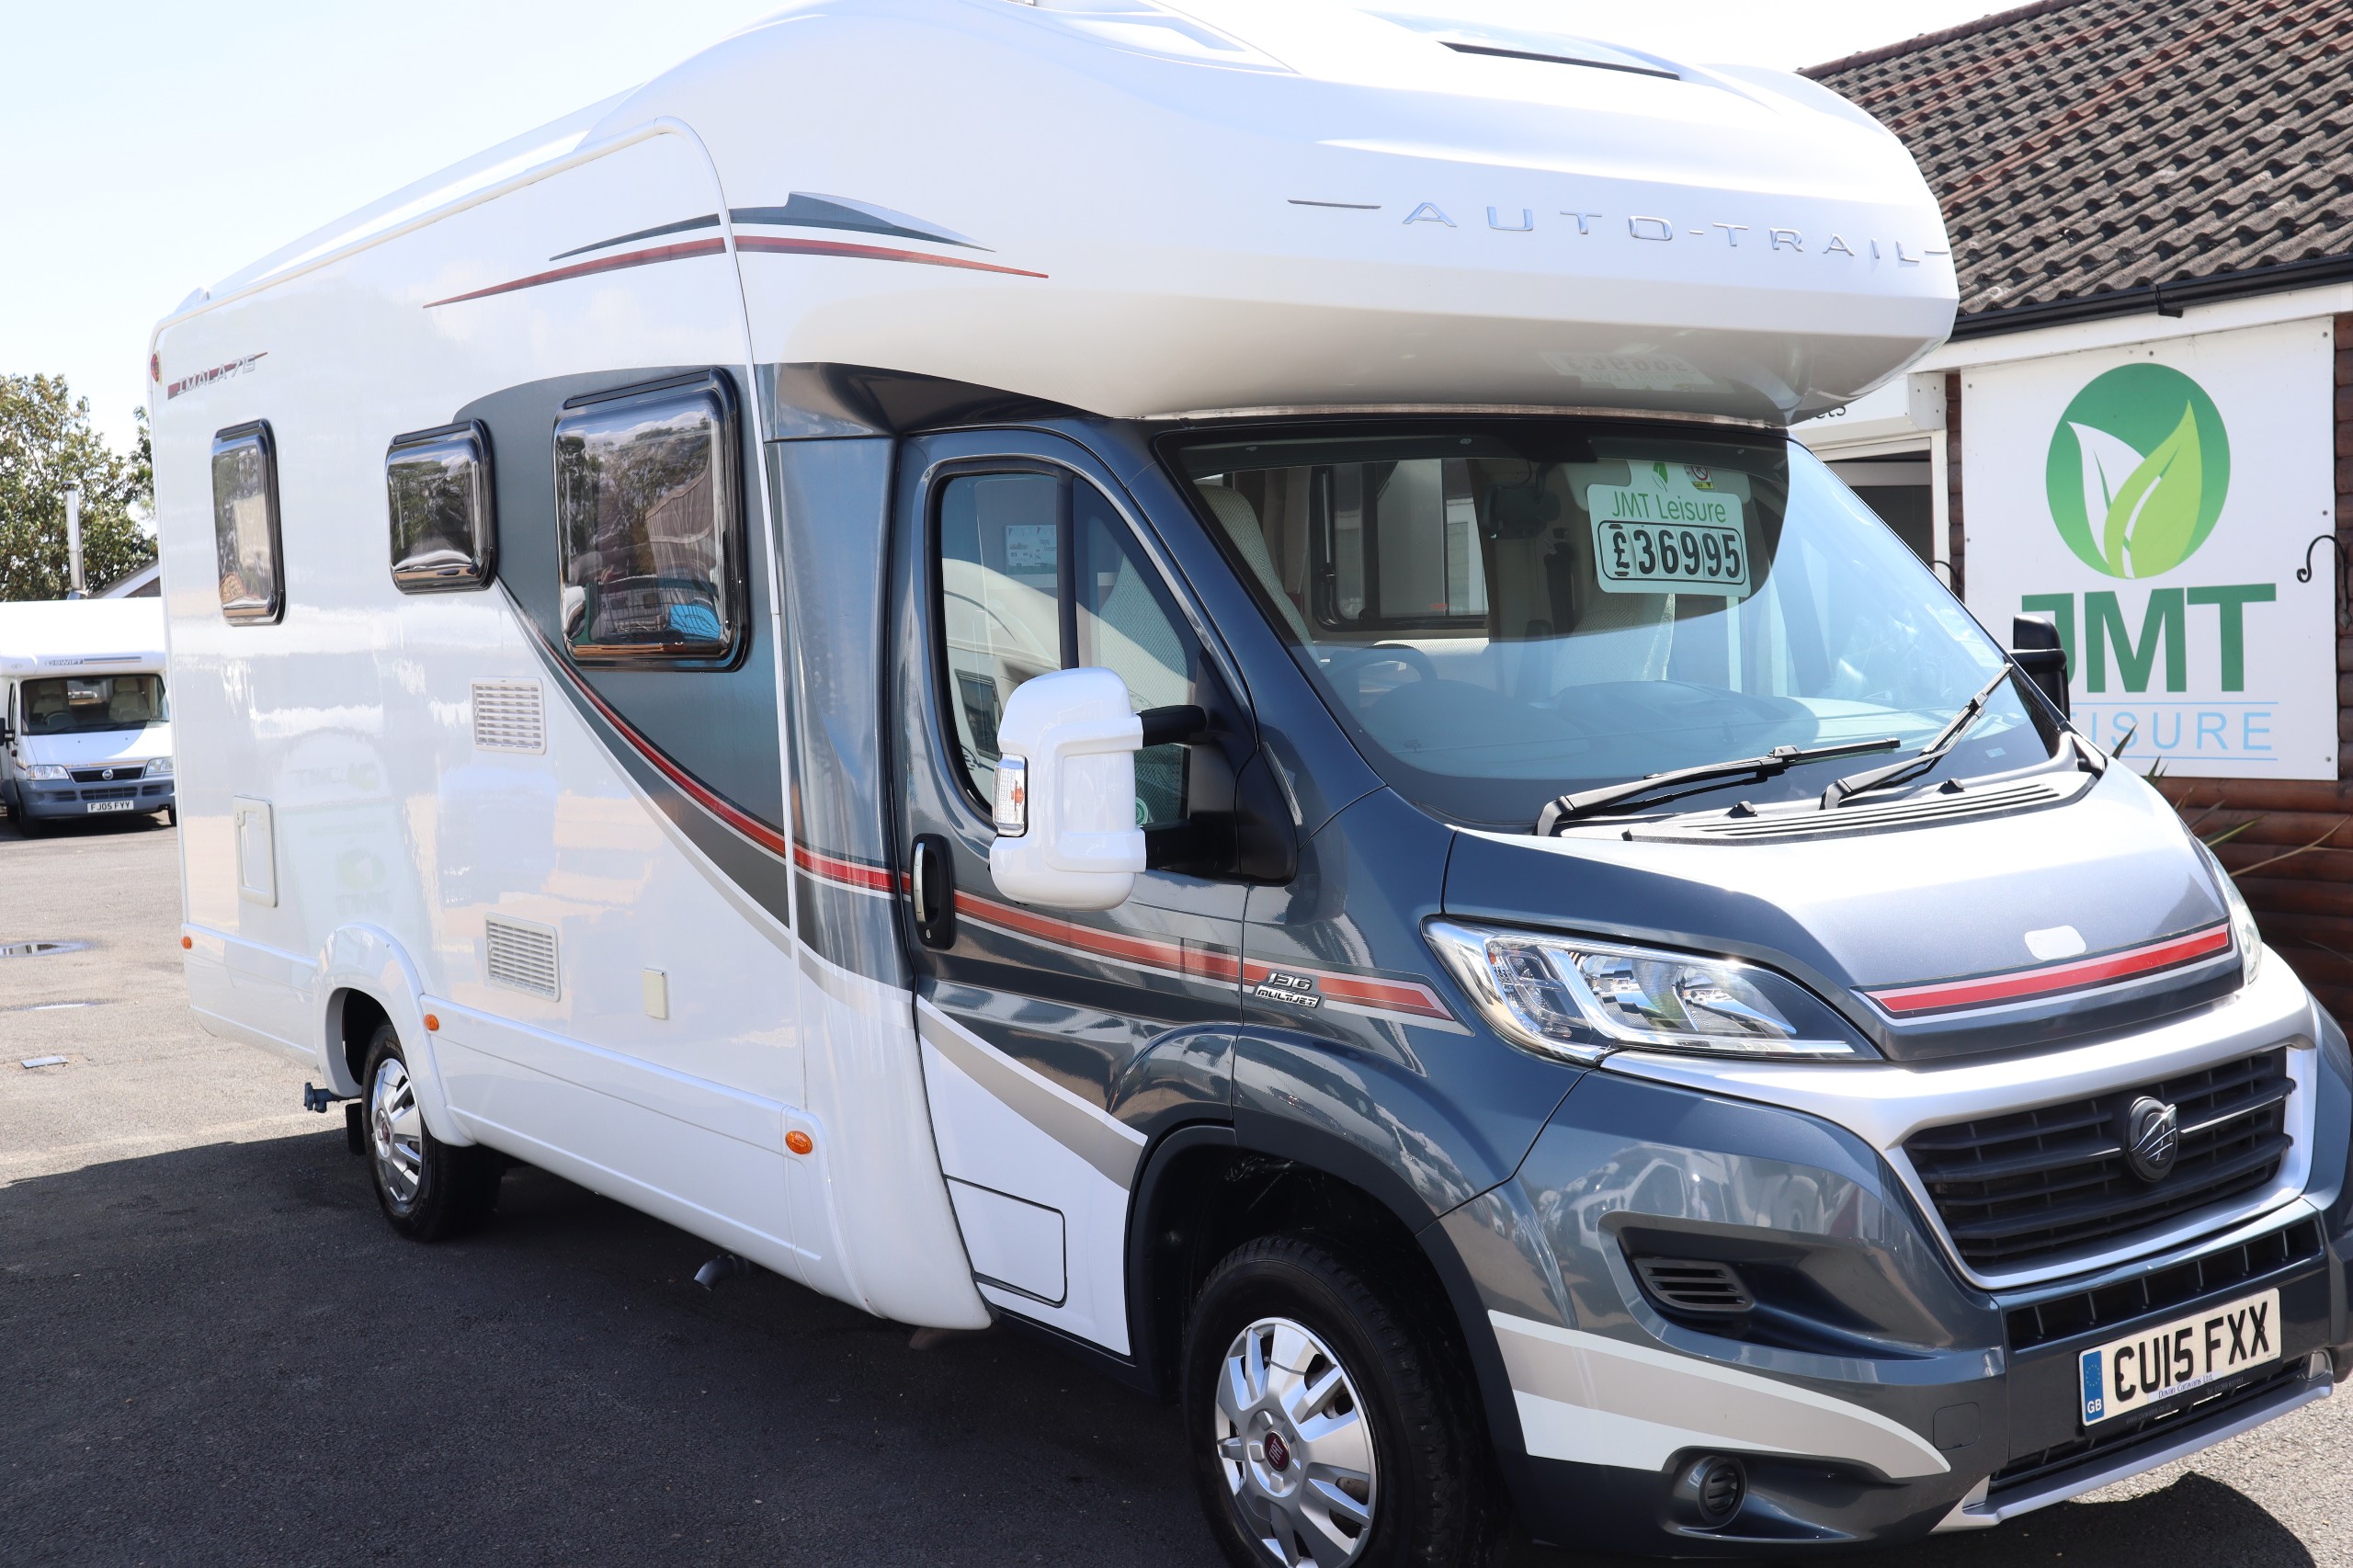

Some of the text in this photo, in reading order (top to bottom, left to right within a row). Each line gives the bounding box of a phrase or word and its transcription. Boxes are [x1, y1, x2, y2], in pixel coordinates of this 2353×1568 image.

[1402, 201, 1920, 264] AUTO-TRAIL
[177, 354, 256, 394] IMALA 715
[1612, 491, 1726, 523] JMT Leisure
[1612, 528, 1741, 579] £36995
[2021, 583, 2277, 693] JMT
[2070, 711, 2273, 752] ISURE
[90, 801, 131, 811] FJ05 FYY
[1256, 989, 1316, 1007] MULTIJET
[2205, 1301, 2269, 1373] FXX
[2177, 1378, 2202, 1392] Caravans
[2086, 1398, 2103, 1415] GB
[1268, 1438, 1283, 1464] FIAT
